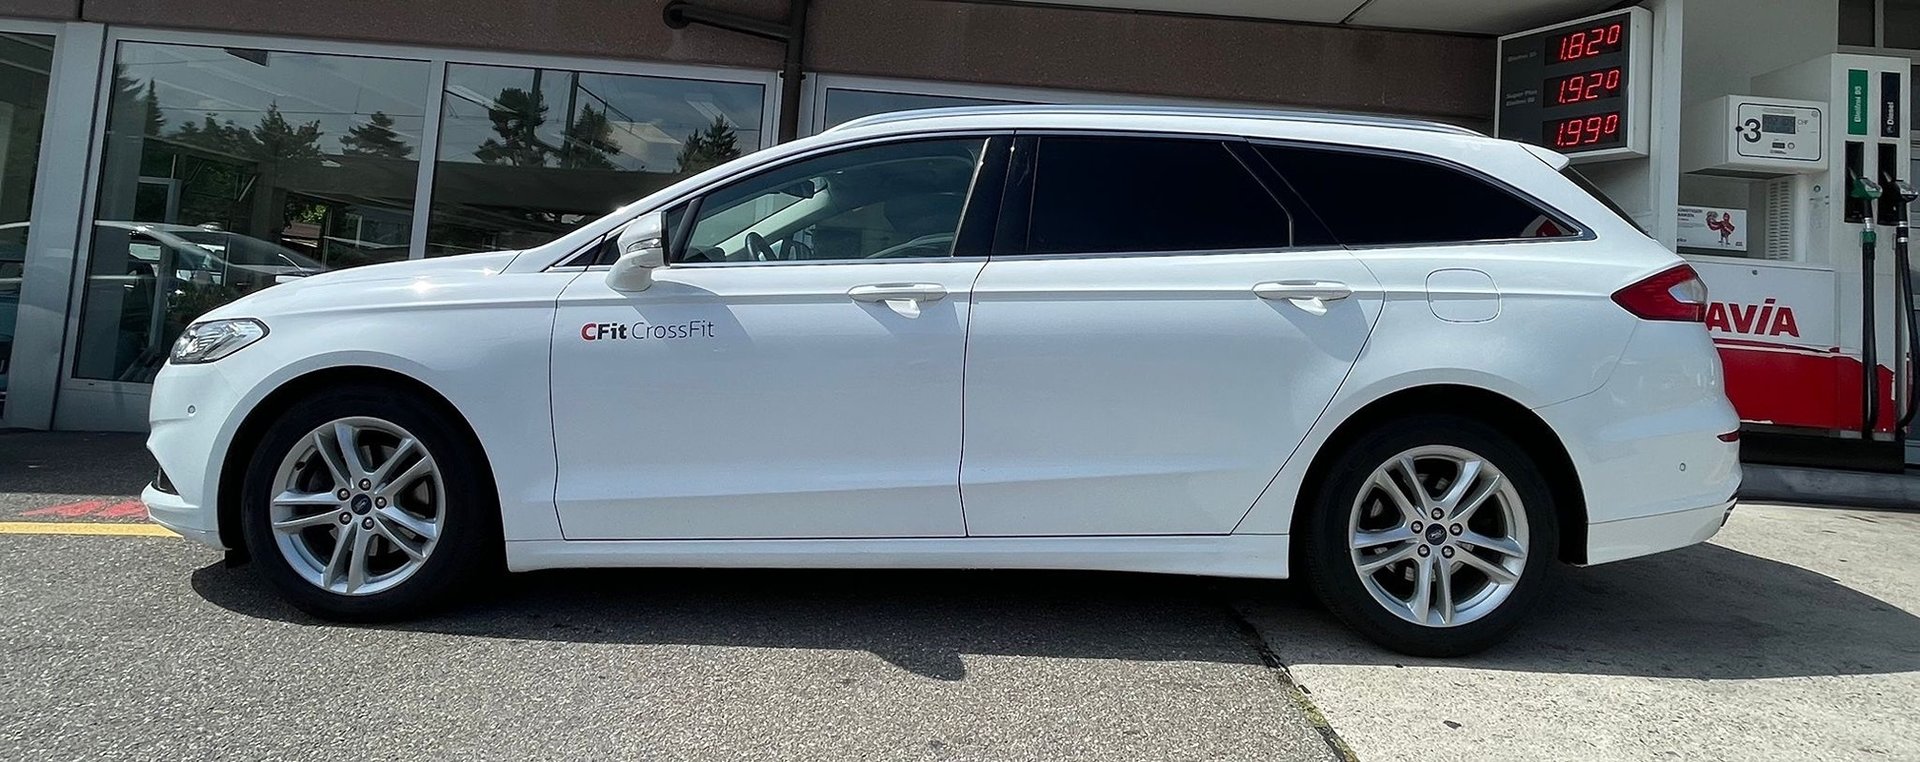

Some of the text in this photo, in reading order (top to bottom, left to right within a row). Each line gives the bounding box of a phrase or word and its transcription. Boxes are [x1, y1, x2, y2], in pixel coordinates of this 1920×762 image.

[1743, 118, 1762, 143] 3
[581, 320, 715, 341] CFit CrossFit
